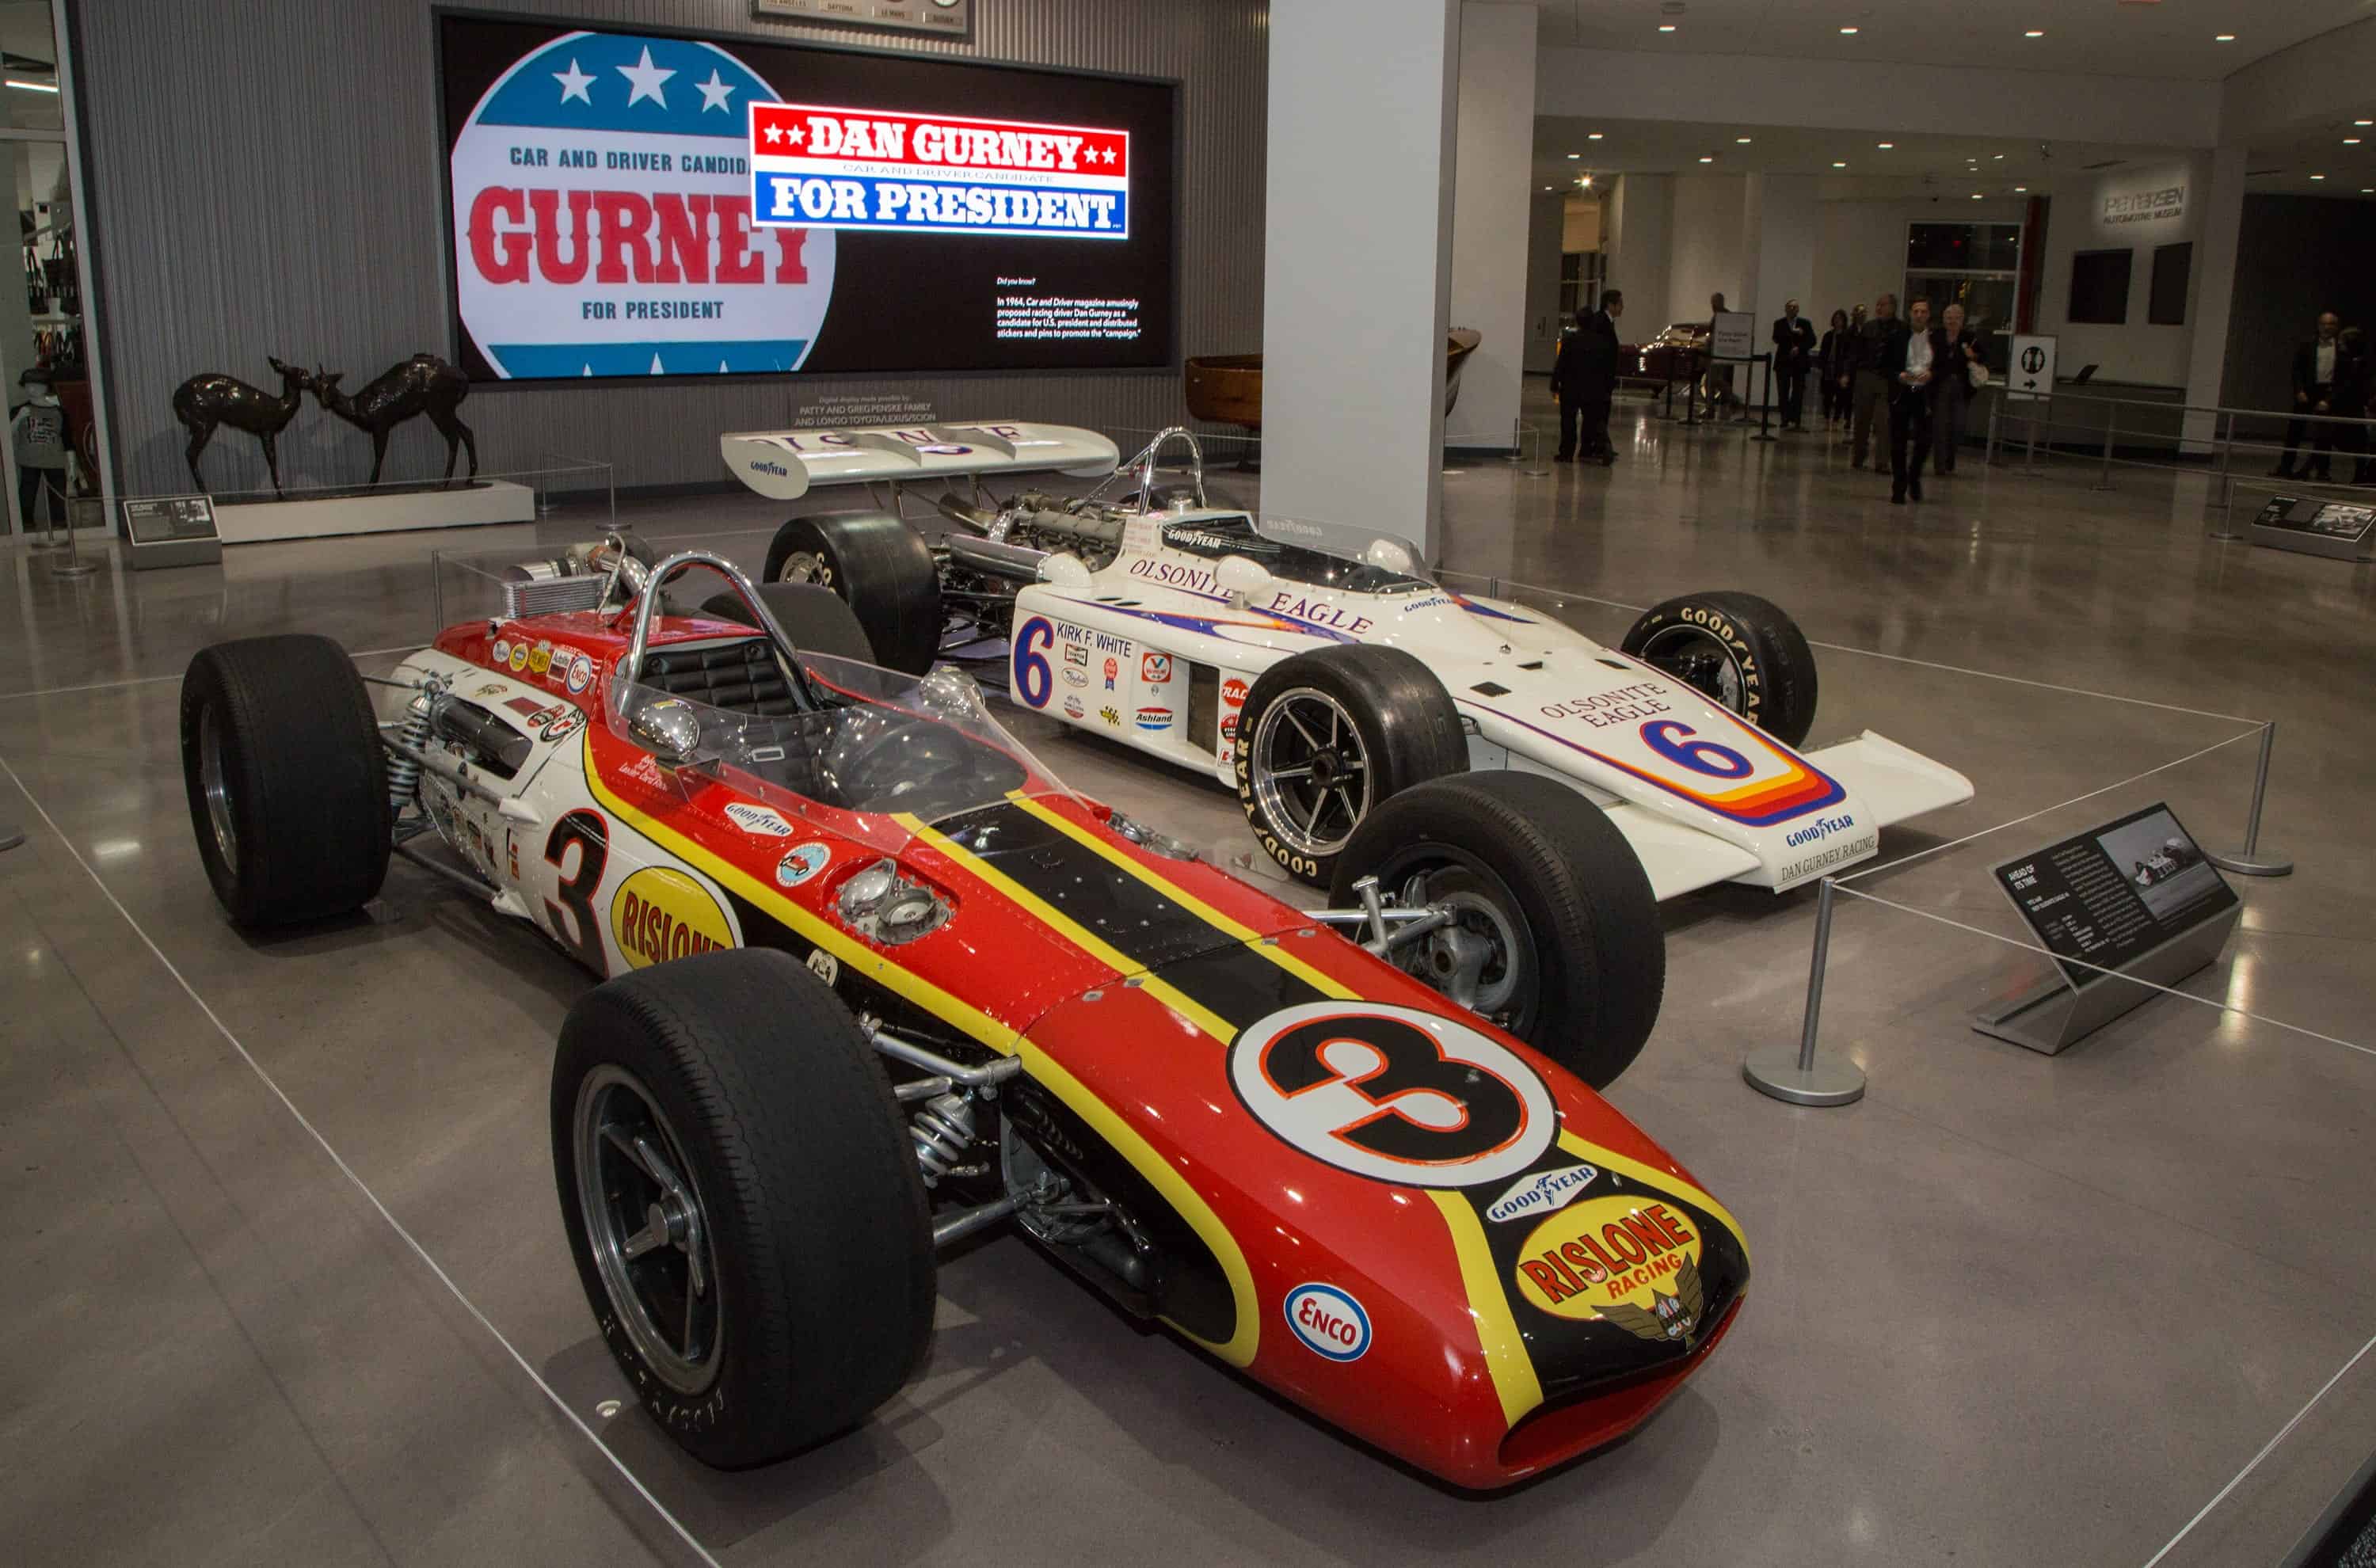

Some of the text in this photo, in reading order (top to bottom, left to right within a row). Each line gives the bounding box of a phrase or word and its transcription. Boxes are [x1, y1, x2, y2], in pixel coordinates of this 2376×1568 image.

[807, 116, 1083, 169] DAN GURNEY
[510, 147, 749, 175] CAR AND DRIVER CANDID
[843, 164, 1053, 184] CAR AND DRIVER CANDIDATE
[771, 177, 1115, 229] FOR PRESIDENT
[466, 185, 808, 284] GURNEY
[582, 302, 724, 319] FOR PRESIDENT
[997, 298, 1138, 310] In 1964, Car and Driver magazine amusingly
[997, 309, 1031, 318] proposed
[1032, 309, 1053, 318] racing
[1089, 309, 1112, 319] Gurney
[997, 329, 1023, 338] stickers
[1038, 329, 1053, 339] pins
[1062, 330, 1090, 339] promote
[1057, 319, 1088, 329] president
[795, 417, 814, 426] AND
[817, 417, 847, 425] LONGO
[800, 405, 824, 415] PATTY
[826, 405, 846, 414] AND
[871, 404, 902, 413] PENSKE
[904, 403, 931, 412] FAMILY
[1167, 528, 1221, 550] GOODYEAR
[1270, 592, 1374, 634] EAGLE
[1057, 622, 1132, 658] KIRK F. WHITE
[1014, 615, 1054, 710] 6
[1137, 714, 1172, 723] Ashland
[1540, 682, 1668, 719] OLSONITE
[1583, 699, 1672, 728] EAGLE
[1639, 719, 1754, 779] 6
[726, 803, 791, 838] GOODYEAR
[1786, 814, 1855, 847] GOODYEAR
[1781, 835, 1875, 881] DAN GURNEY RACING
[544, 808, 609, 980] 3
[1258, 1013, 1529, 1167] 3
[1491, 1166, 1594, 1220] GOODYEAR
[1519, 1204, 1695, 1305] RISLONE
[1605, 1254, 1682, 1300] RACING
[1297, 1298, 1357, 1346] ENCO
